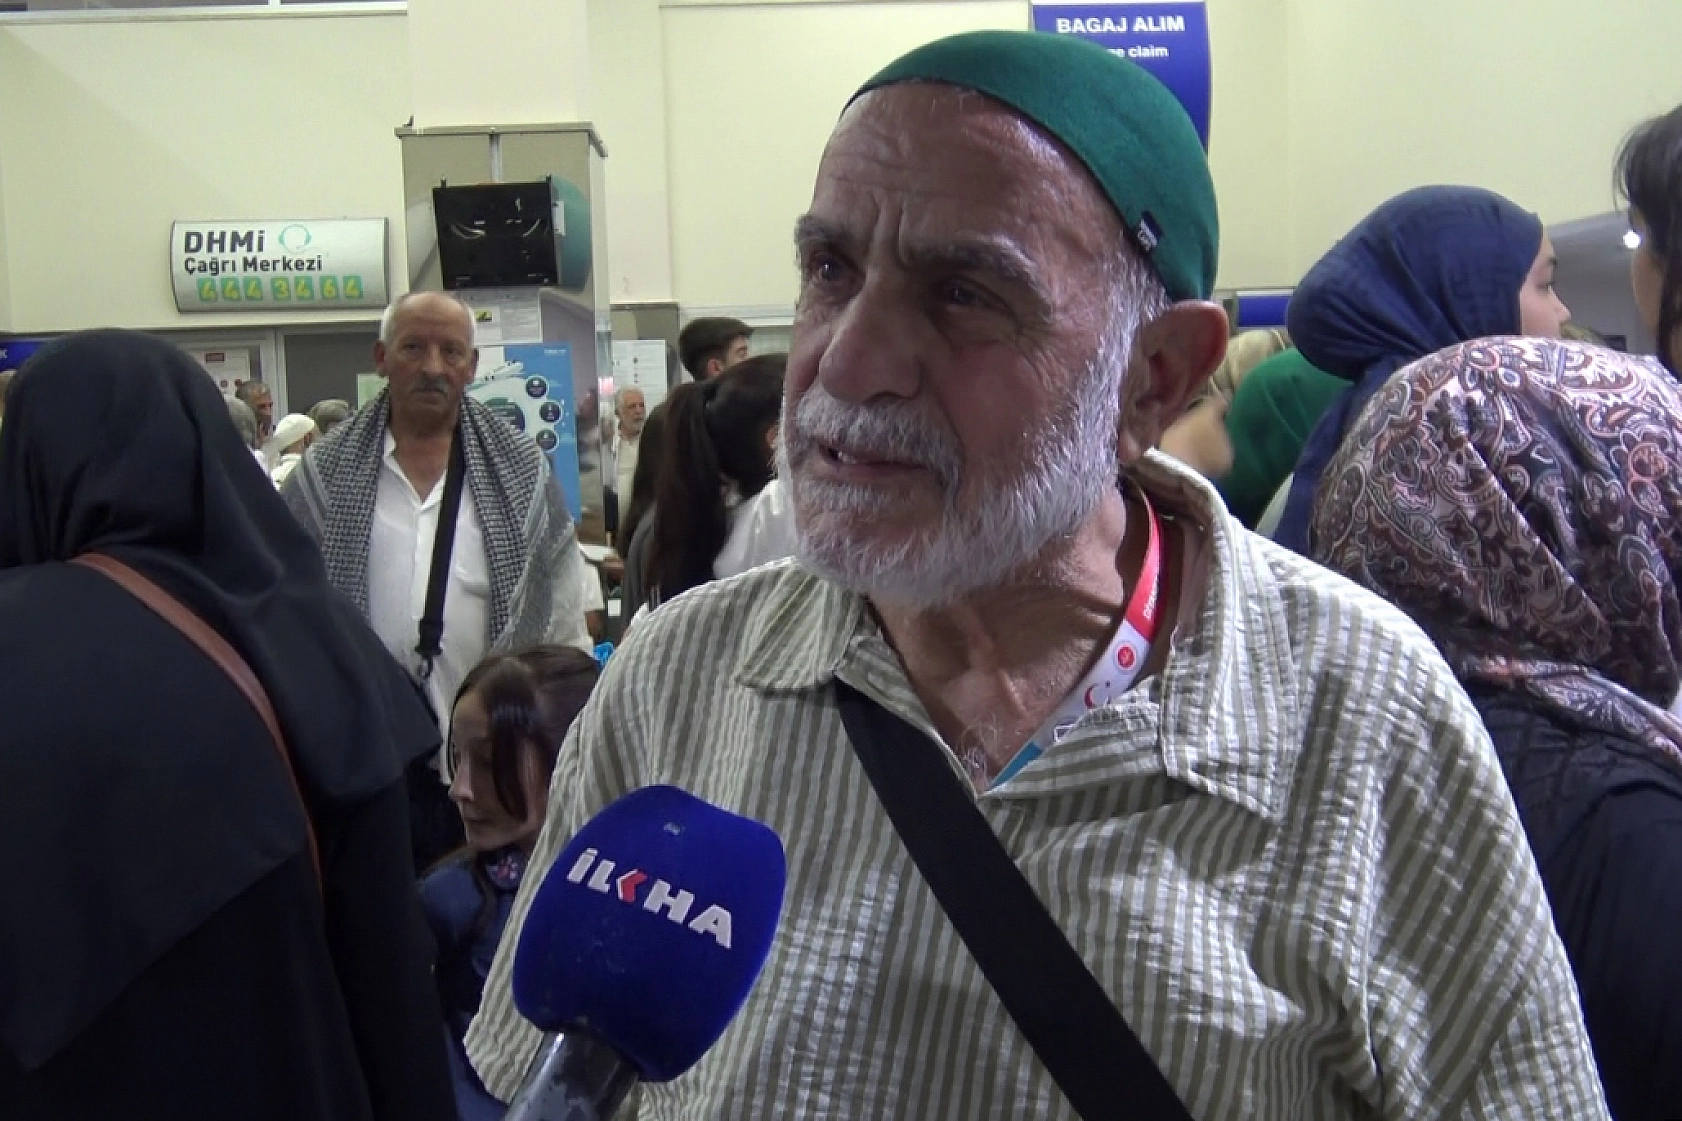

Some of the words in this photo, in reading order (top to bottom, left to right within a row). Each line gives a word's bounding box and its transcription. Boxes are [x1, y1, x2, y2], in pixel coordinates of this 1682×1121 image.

[1056, 17, 1127, 33] BAGAJ
[1133, 16, 1186, 32] ALIM
[1128, 44, 1169, 58] claim
[184, 257, 236, 276] Çağrı
[243, 255, 322, 272] Merkezi
